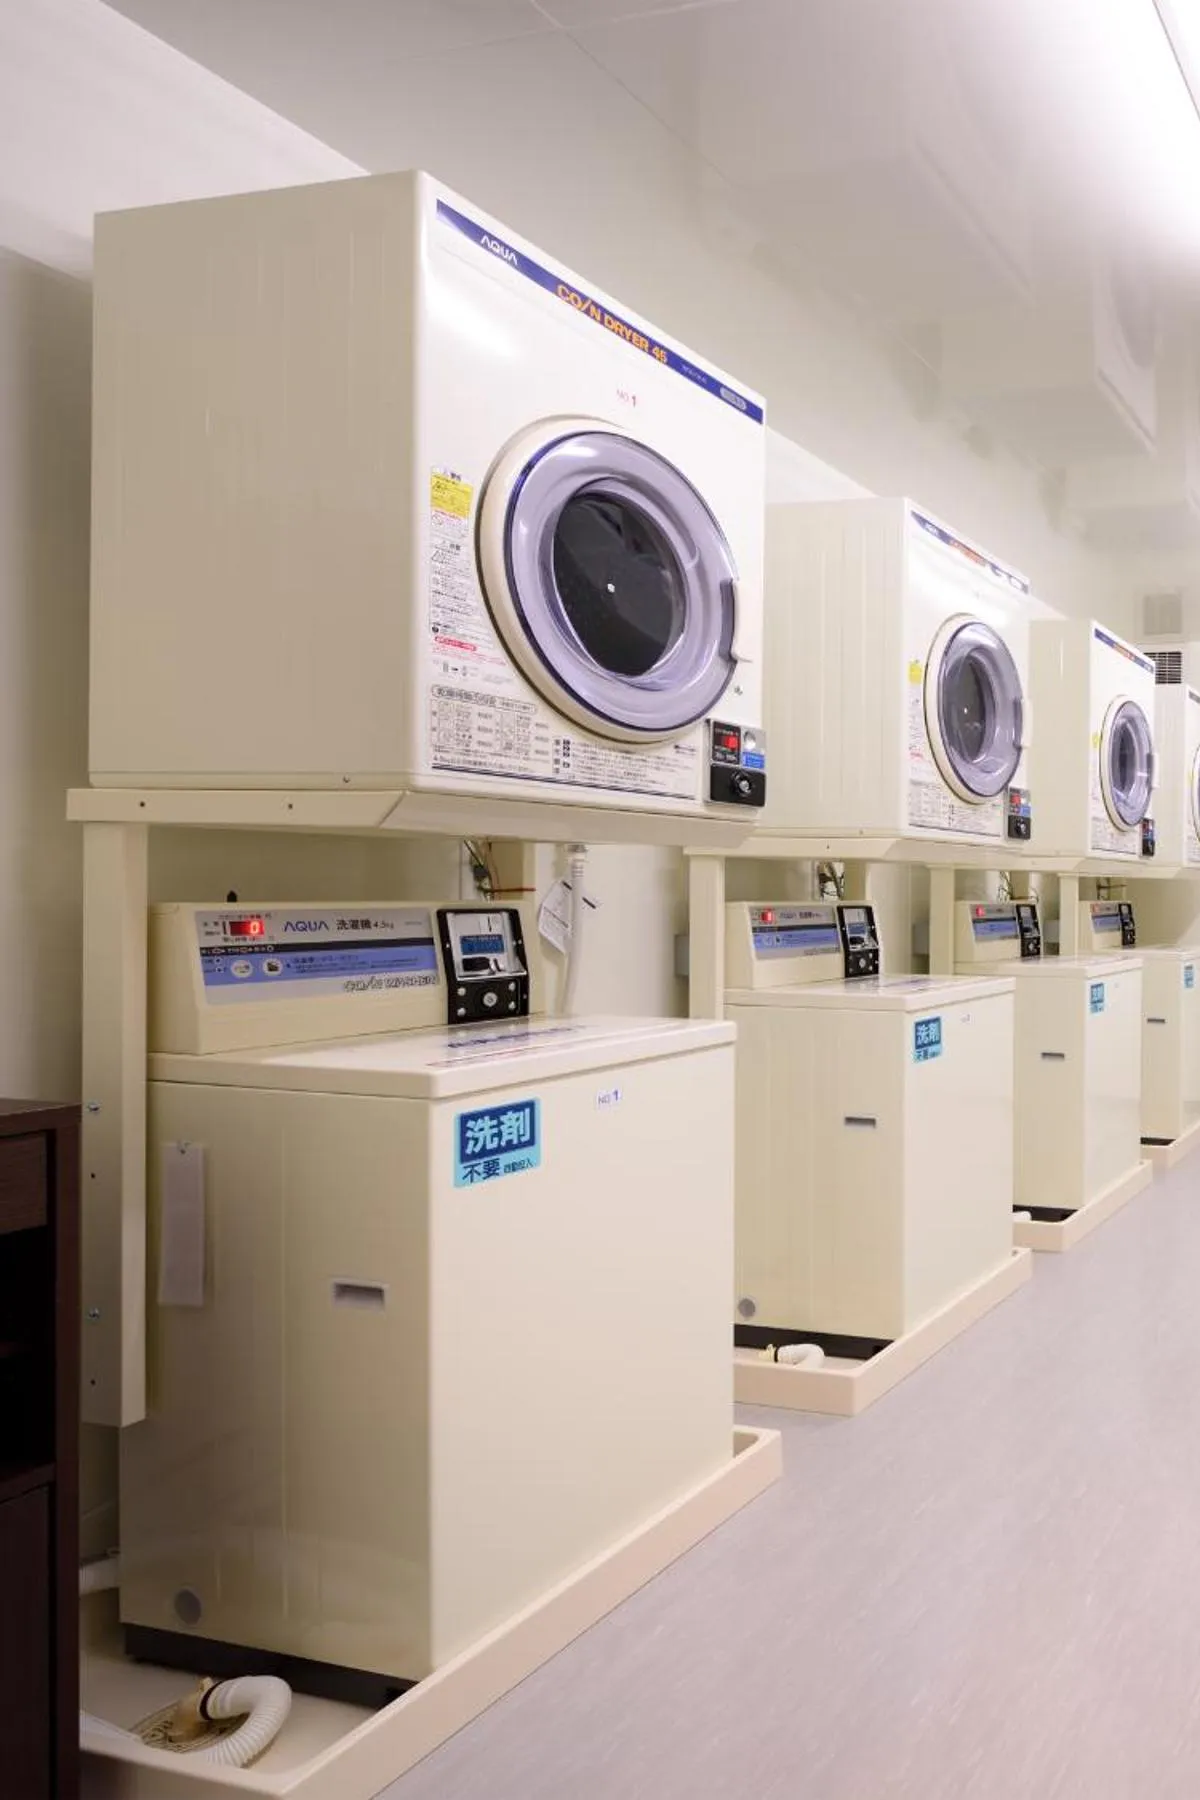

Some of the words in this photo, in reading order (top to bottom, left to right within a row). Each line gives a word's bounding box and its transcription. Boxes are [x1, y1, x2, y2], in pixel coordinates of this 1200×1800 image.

[481, 235, 518, 266] AQUA
[604, 313, 649, 353] DRYER
[250, 920, 260, 934] 0
[284, 921, 329, 932] AQUA
[465, 1108, 531, 1155] 洗剤
[461, 1157, 501, 1184] 不要
